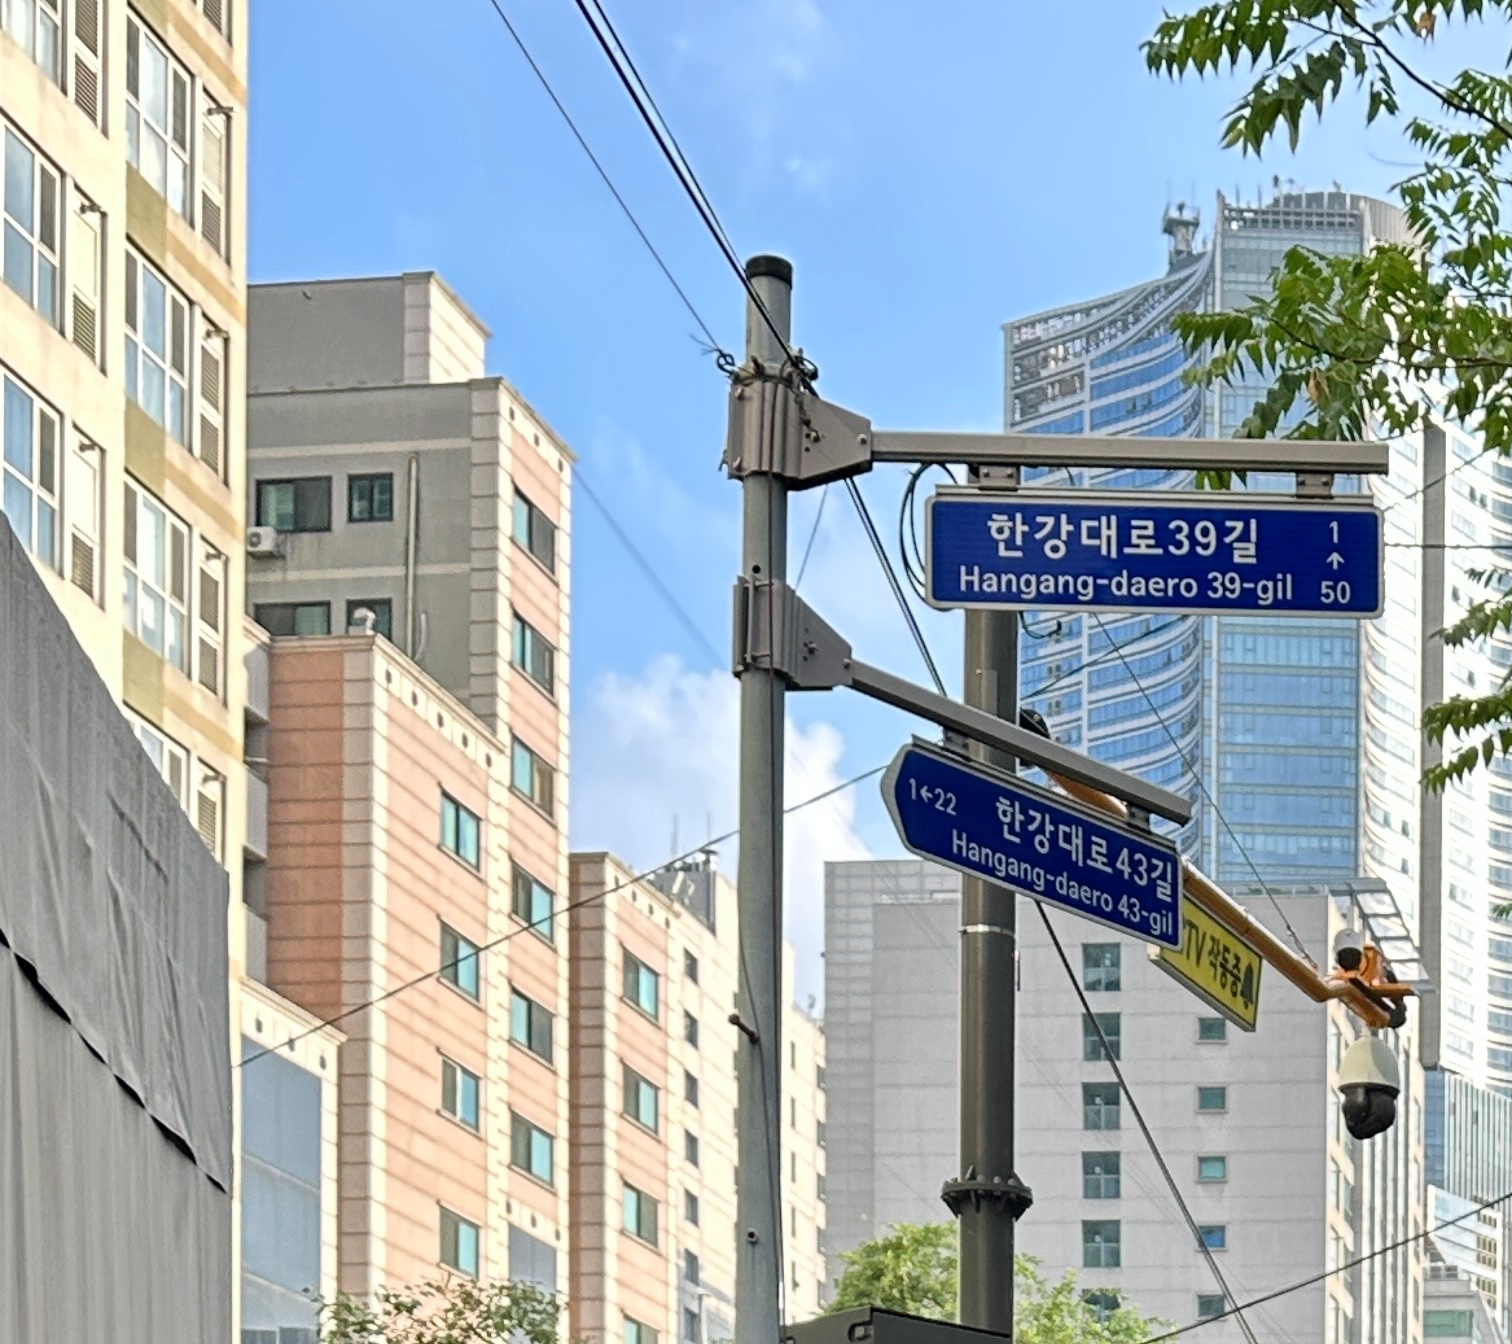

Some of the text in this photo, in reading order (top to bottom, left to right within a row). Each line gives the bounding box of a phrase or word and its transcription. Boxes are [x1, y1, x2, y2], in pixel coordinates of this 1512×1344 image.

[987, 512, 1258, 564] 한강대로39길
[1328, 521, 1338, 543] 1
[960, 565, 1292, 605] Hangang-daero 39-gil
[1321, 581, 1351, 604] 50
[908, 777, 957, 816] 1 22
[996, 795, 1173, 903] 한강대로43길
[952, 829, 1173, 936] Hangang-daero 43-gil
[1182, 918, 1242, 998] TV 작동중
